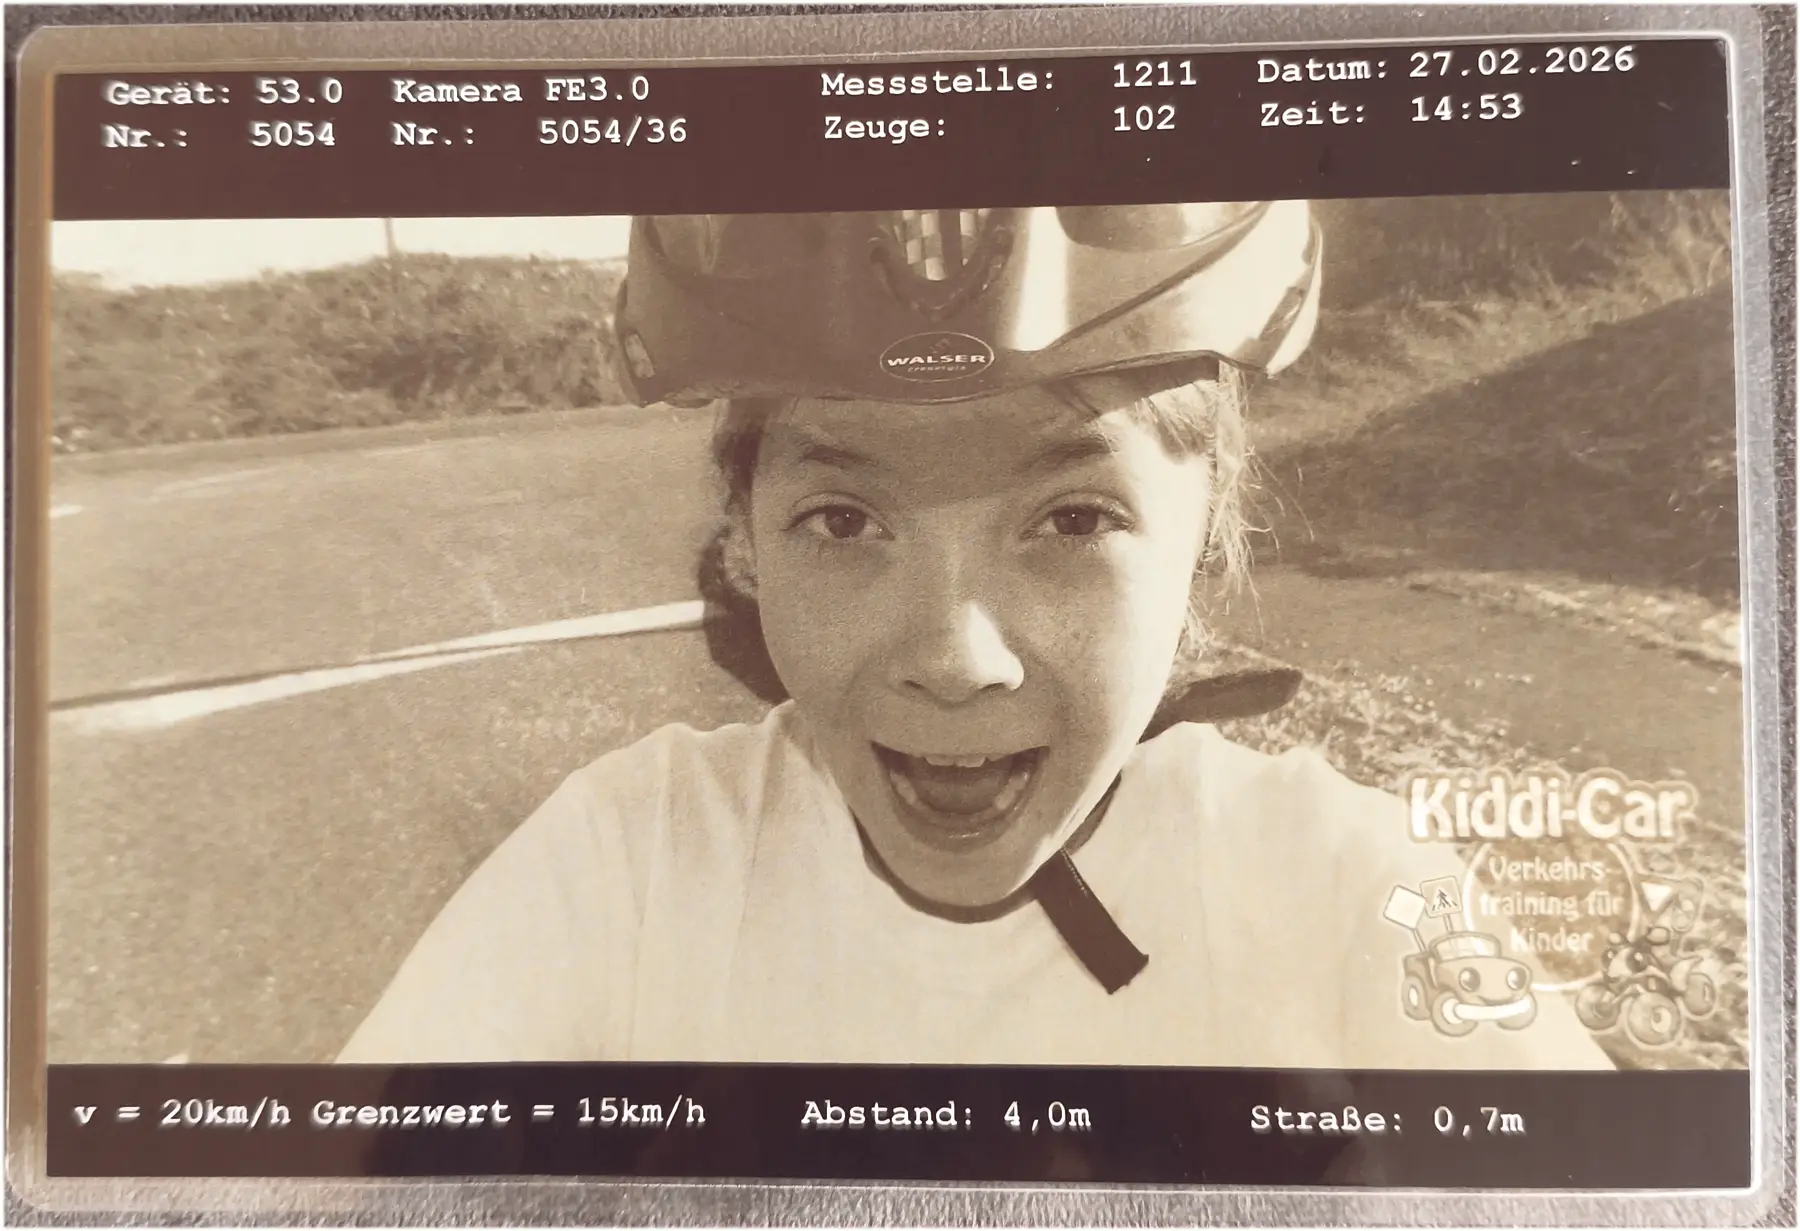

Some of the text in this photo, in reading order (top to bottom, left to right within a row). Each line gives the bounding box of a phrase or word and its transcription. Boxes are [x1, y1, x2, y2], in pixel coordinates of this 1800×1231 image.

[1114, 60, 1198, 88] 1211
[1257, 45, 1636, 84] Datum: 27.02.2026
[105, 75, 650, 106] Gerät: 53.0 Kamera FE3.0
[821, 67, 1054, 96] Messstelle:
[1113, 104, 1176, 131] 102
[1260, 92, 1523, 127] Zeit: 14:53
[104, 116, 688, 148] Nr.: 5054 Nr.: 5054/36
[823, 115, 947, 144] Zeuge:
[887, 355, 986, 367] WALSER
[1409, 775, 1689, 839] Kiddi-Car
[1488, 856, 1608, 881] Verkehrs-
[1479, 891, 1623, 921] training für
[1510, 927, 1594, 953] Kinder
[74, 1096, 706, 1128] v = 20km/h Grenzwert = 15km/h
[801, 1099, 1092, 1133] Abstand: 4,0m
[1250, 1105, 1525, 1137] Straße: 0,7m
